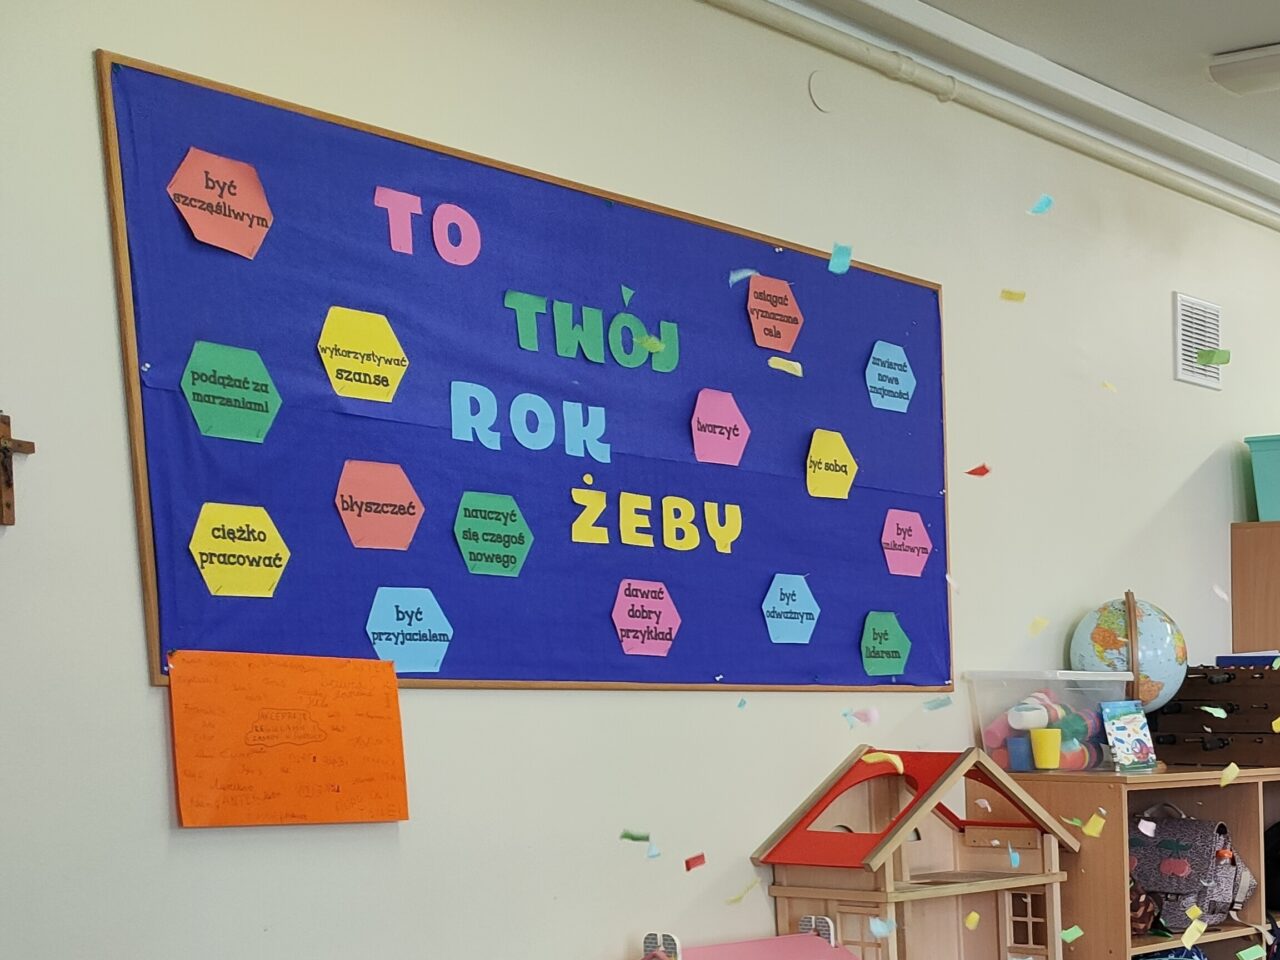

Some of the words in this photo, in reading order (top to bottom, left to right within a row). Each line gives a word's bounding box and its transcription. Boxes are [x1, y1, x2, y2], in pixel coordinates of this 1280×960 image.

[204, 170, 237, 199] być
[172, 193, 269, 228] szczęśliwym
[374, 185, 481, 266] TO
[753, 290, 788, 307] osiągać
[504, 284, 680, 373] TWÓJ
[763, 325, 782, 338] cele
[319, 344, 408, 367] wykorzystywać
[191, 369, 250, 390] podążać
[252, 381, 270, 393] za
[335, 368, 390, 388] szanse
[877, 373, 899, 385] nowe
[191, 391, 269, 413] marzeniami
[451, 381, 611, 463] ROK
[697, 417, 740, 440] tworzyć
[824, 458, 848, 475] sobą
[340, 494, 416, 517] błyszczeć
[571, 473, 743, 554] ŻEBY
[463, 507, 517, 526] nauczyć
[211, 524, 267, 542] ciężko
[462, 528, 479, 544] się
[482, 532, 525, 548] czegoś
[896, 523, 912, 540] być
[198, 550, 283, 569] pracować
[469, 551, 517, 568] nowego
[624, 583, 664, 600] dawać
[779, 588, 797, 606] być
[394, 605, 424, 626] być
[628, 604, 662, 624] dobry
[766, 607, 815, 623] odważnym
[371, 629, 451, 645] przyjacielem
[620, 627, 673, 643] przykład
[872, 628, 889, 644] być
[865, 646, 901, 659] liderem
